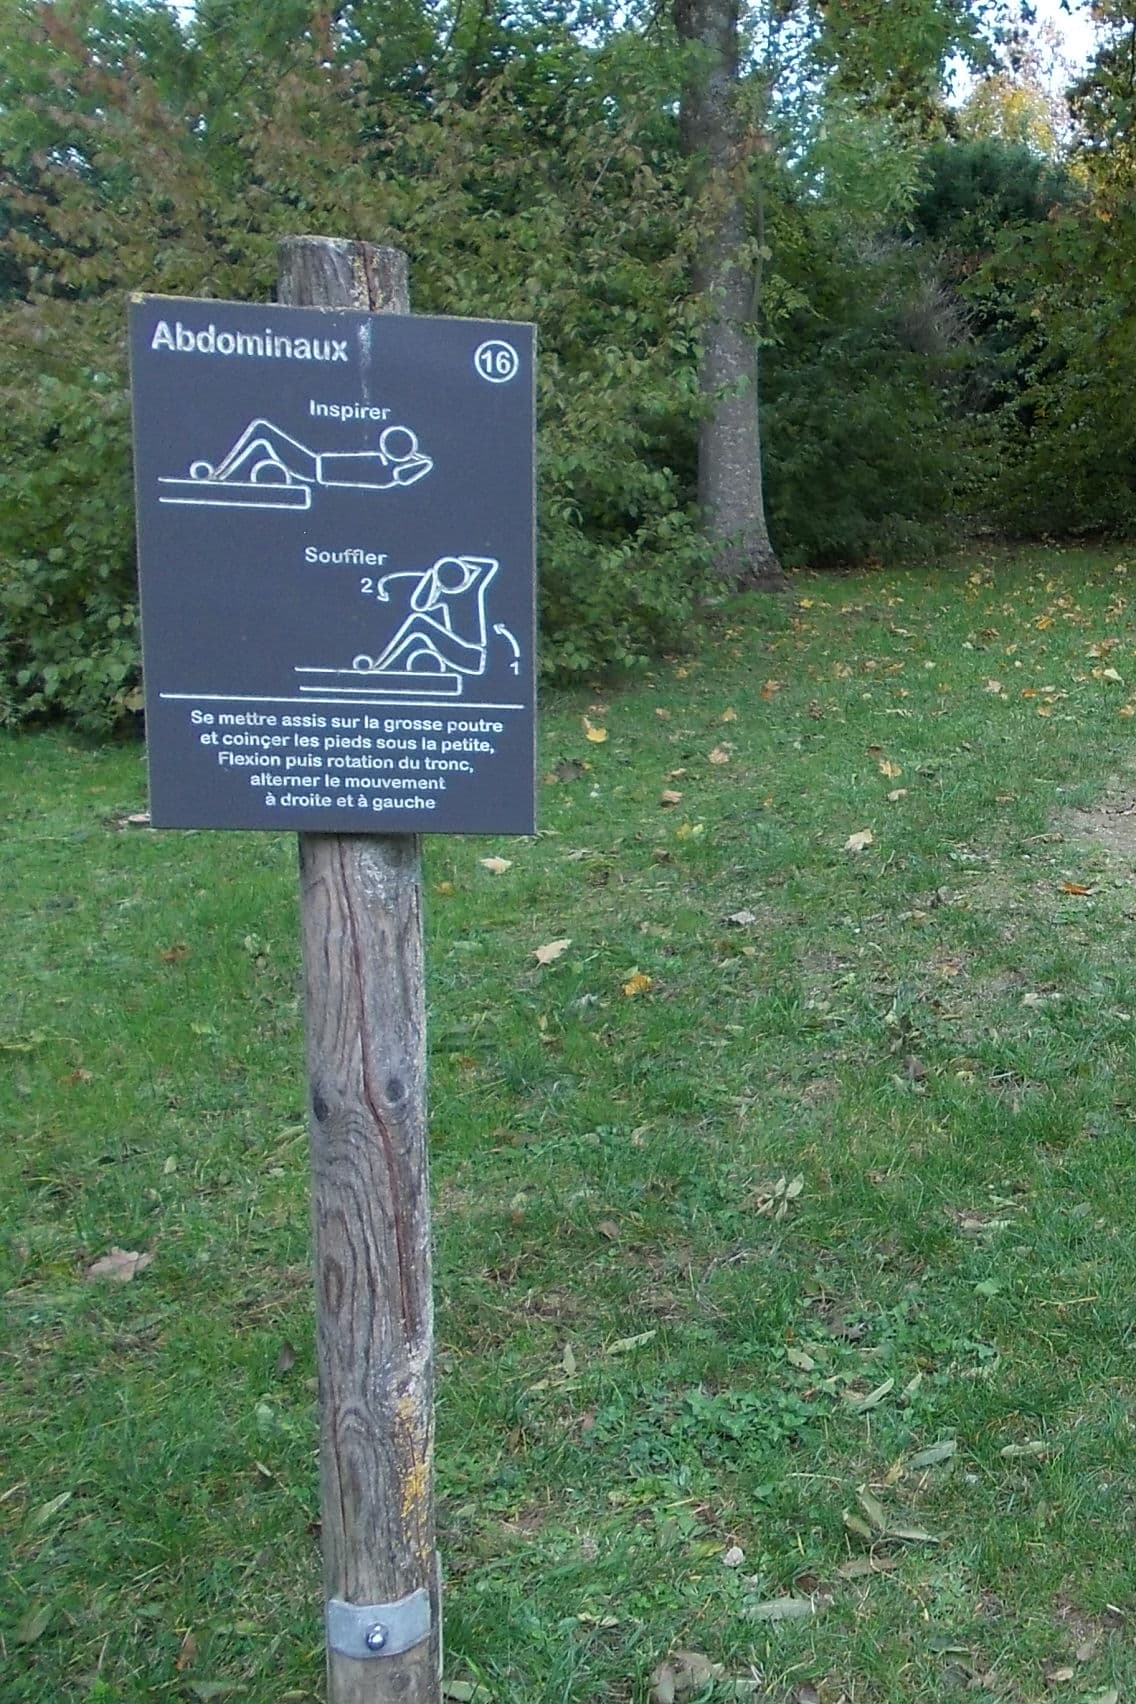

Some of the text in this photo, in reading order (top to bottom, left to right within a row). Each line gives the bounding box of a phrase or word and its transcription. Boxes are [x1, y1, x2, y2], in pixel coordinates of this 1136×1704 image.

[151, 320, 349, 362] Abdominaux
[480, 350, 511, 375] 16
[309, 400, 391, 421] Inspirer
[304, 546, 389, 566] Souffler
[360, 577, 373, 593] 2
[509, 661, 519, 675] 1
[190, 710, 504, 734] Se mettre assis sur la grosse poutre
[200, 731, 495, 754] et coinçer les pieds sous la petite,
[218, 751, 474, 774] Flexion puis rotation du tronc,
[250, 772, 447, 790] alterner le mouvement
[265, 792, 436, 812] à droite et à gauche
